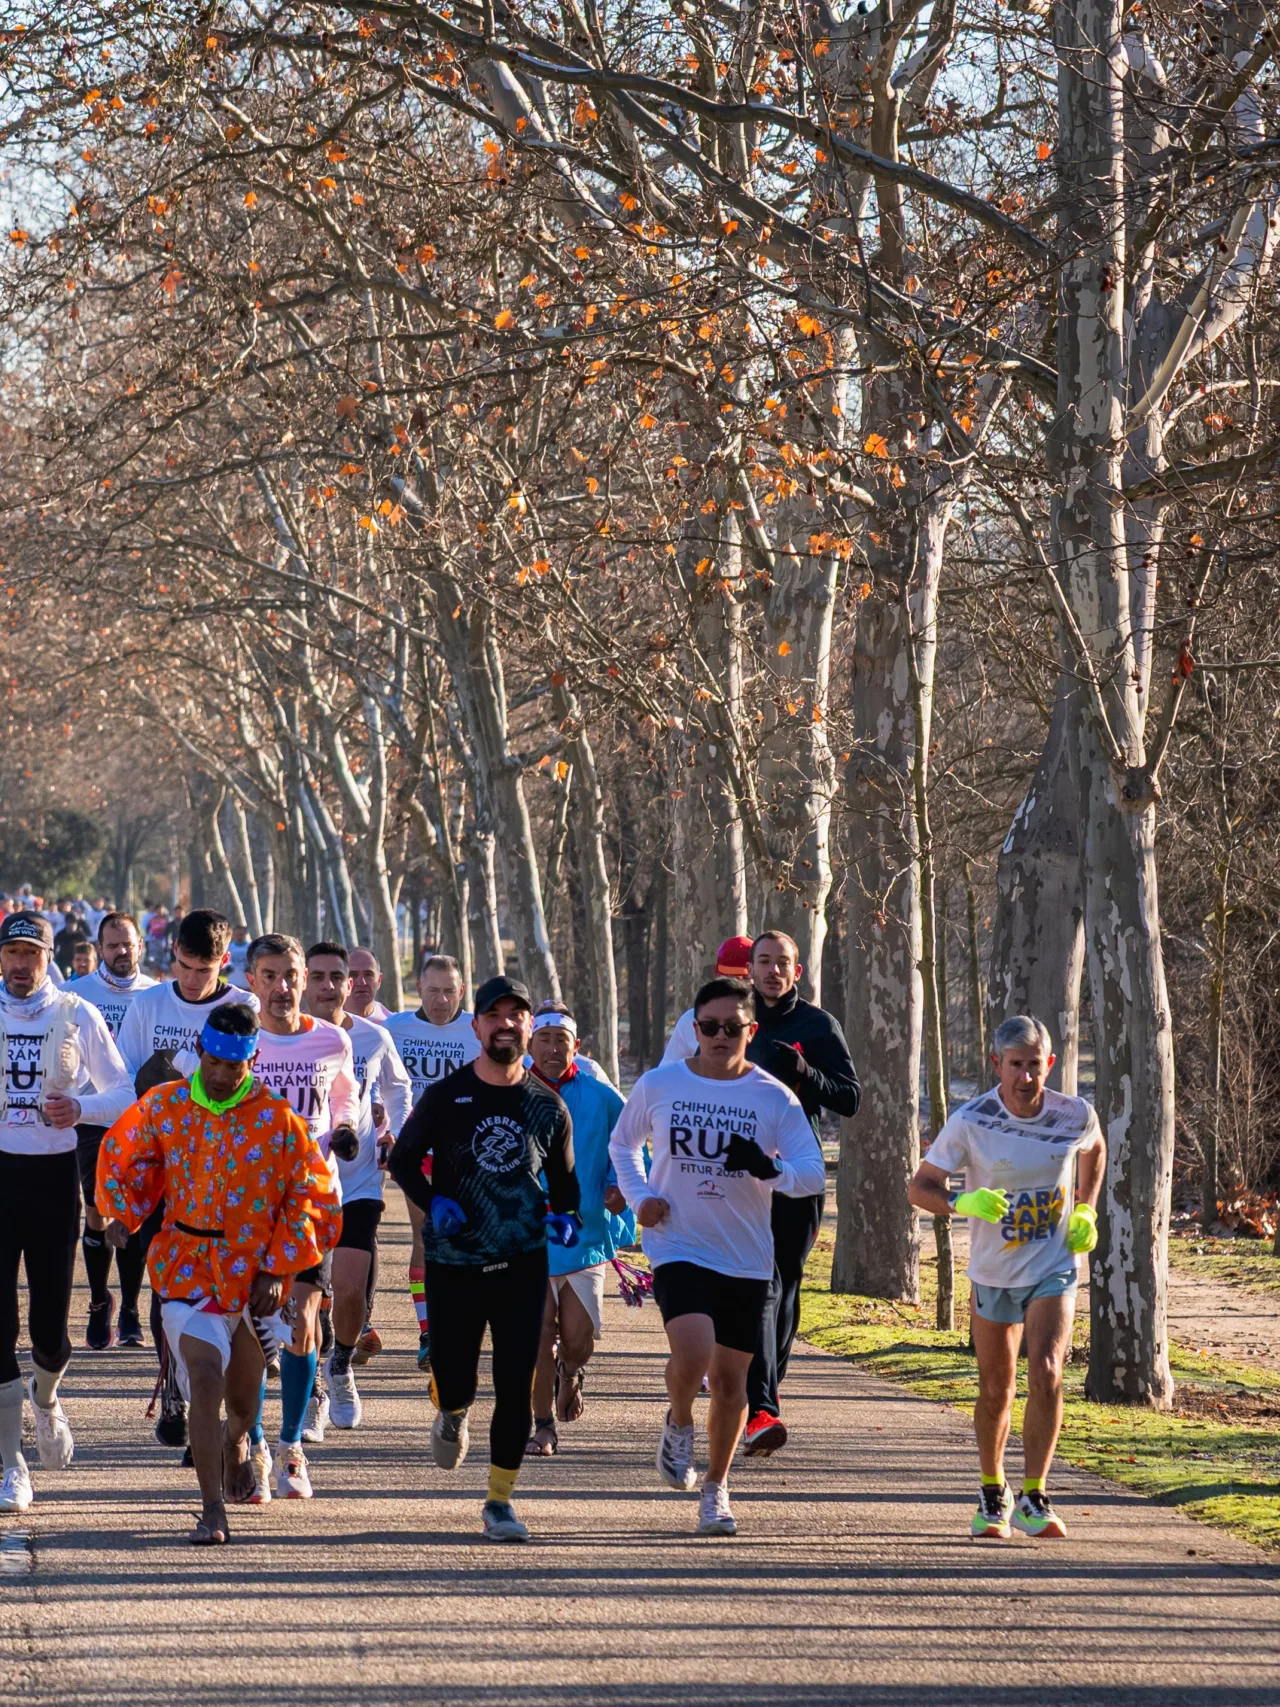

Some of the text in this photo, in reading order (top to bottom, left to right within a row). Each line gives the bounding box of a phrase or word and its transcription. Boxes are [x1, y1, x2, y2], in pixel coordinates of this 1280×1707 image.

[97, 1004, 128, 1012] CHIHU
[154, 1025, 201, 1039] CHIHUA
[403, 1039, 465, 1050] CHIHUAHUA
[402, 1046, 465, 1059] RARÁMURI
[252, 1062, 328, 1074] CHIHUAHUA
[403, 1056, 464, 1079] RUN
[672, 1101, 757, 1121] CHIHUAHUA
[476, 1116, 522, 1133] LIEBRES
[671, 1113, 757, 1137] RARÁMURI
[670, 1126, 756, 1160] RU
[480, 1158, 521, 1173] RUN CLUB
[681, 1163, 744, 1178] FITUR 2026
